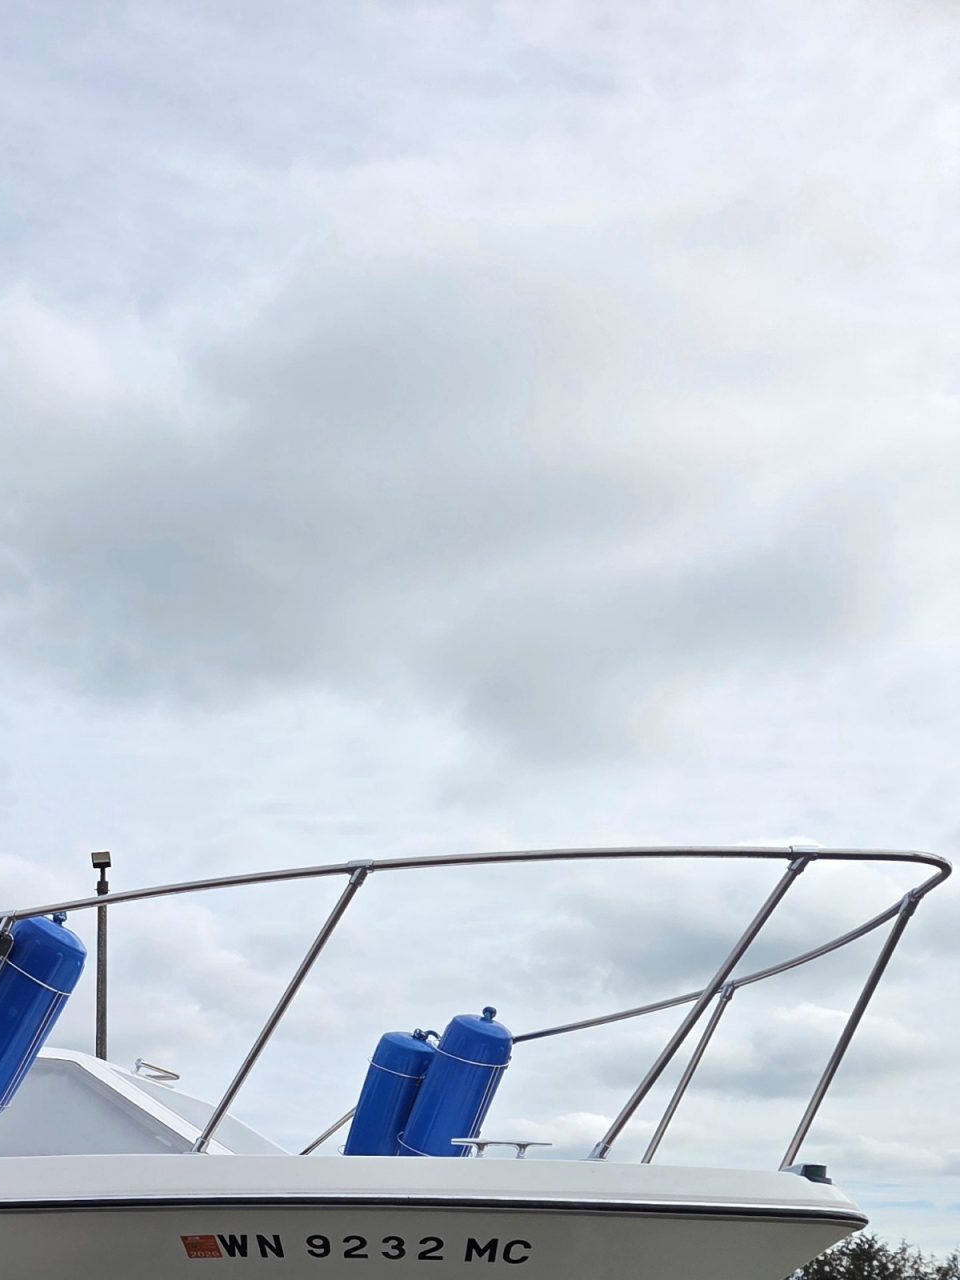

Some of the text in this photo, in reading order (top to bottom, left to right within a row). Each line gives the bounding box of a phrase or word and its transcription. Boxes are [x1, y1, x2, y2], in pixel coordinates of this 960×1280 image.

[217, 1233, 532, 1265] WN 9232 MC
